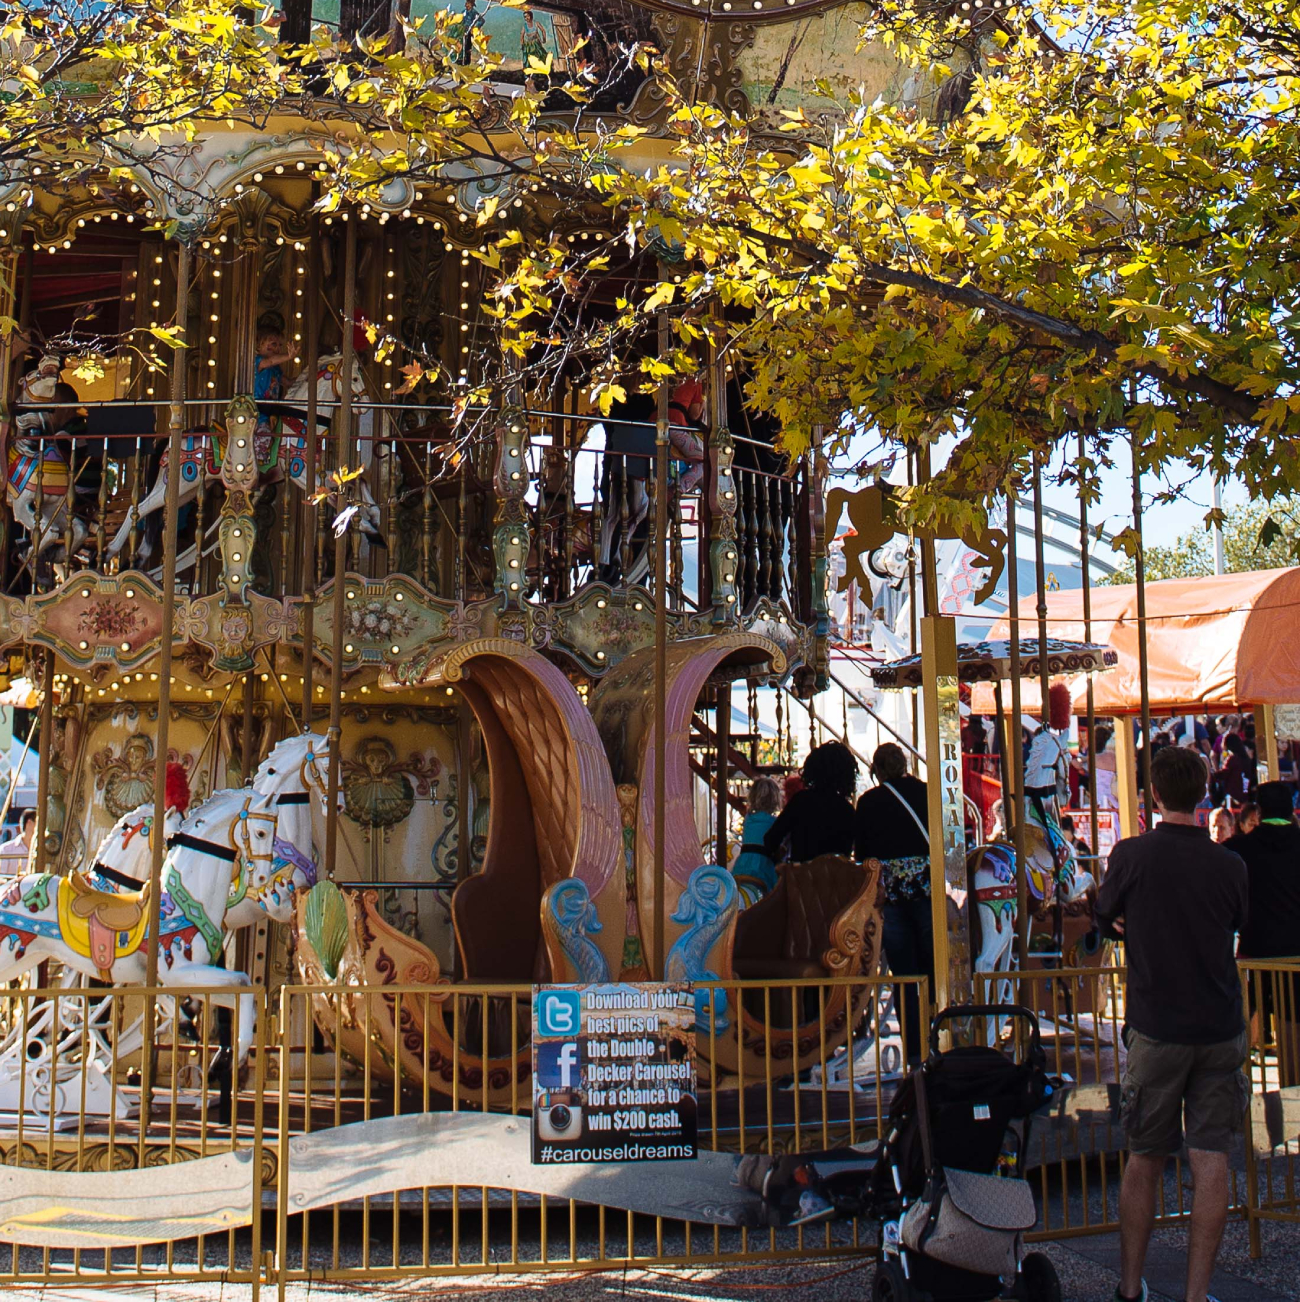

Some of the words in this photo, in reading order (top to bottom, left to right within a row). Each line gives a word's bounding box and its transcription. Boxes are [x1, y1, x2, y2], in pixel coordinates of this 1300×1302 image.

[944, 744, 960, 848] ROYAL
[587, 991, 649, 1010] Download
[650, 993, 678, 1011] your
[587, 1016, 615, 1033] best
[616, 1016, 644, 1036] pics
[646, 1015, 659, 1033] of
[587, 1041, 609, 1058] the
[610, 1040, 655, 1058] Double
[588, 1064, 632, 1082] Decker
[634, 1062, 691, 1081] Carousel
[588, 1089, 607, 1106] for
[608, 1092, 617, 1106] a
[618, 1088, 665, 1105] chance
[667, 1089, 680, 1104] to
[588, 1113, 611, 1131] win
[614, 1110, 646, 1131] $200
[648, 1110, 682, 1129] cash.
[540, 1143, 693, 1162] #carouseldreams
